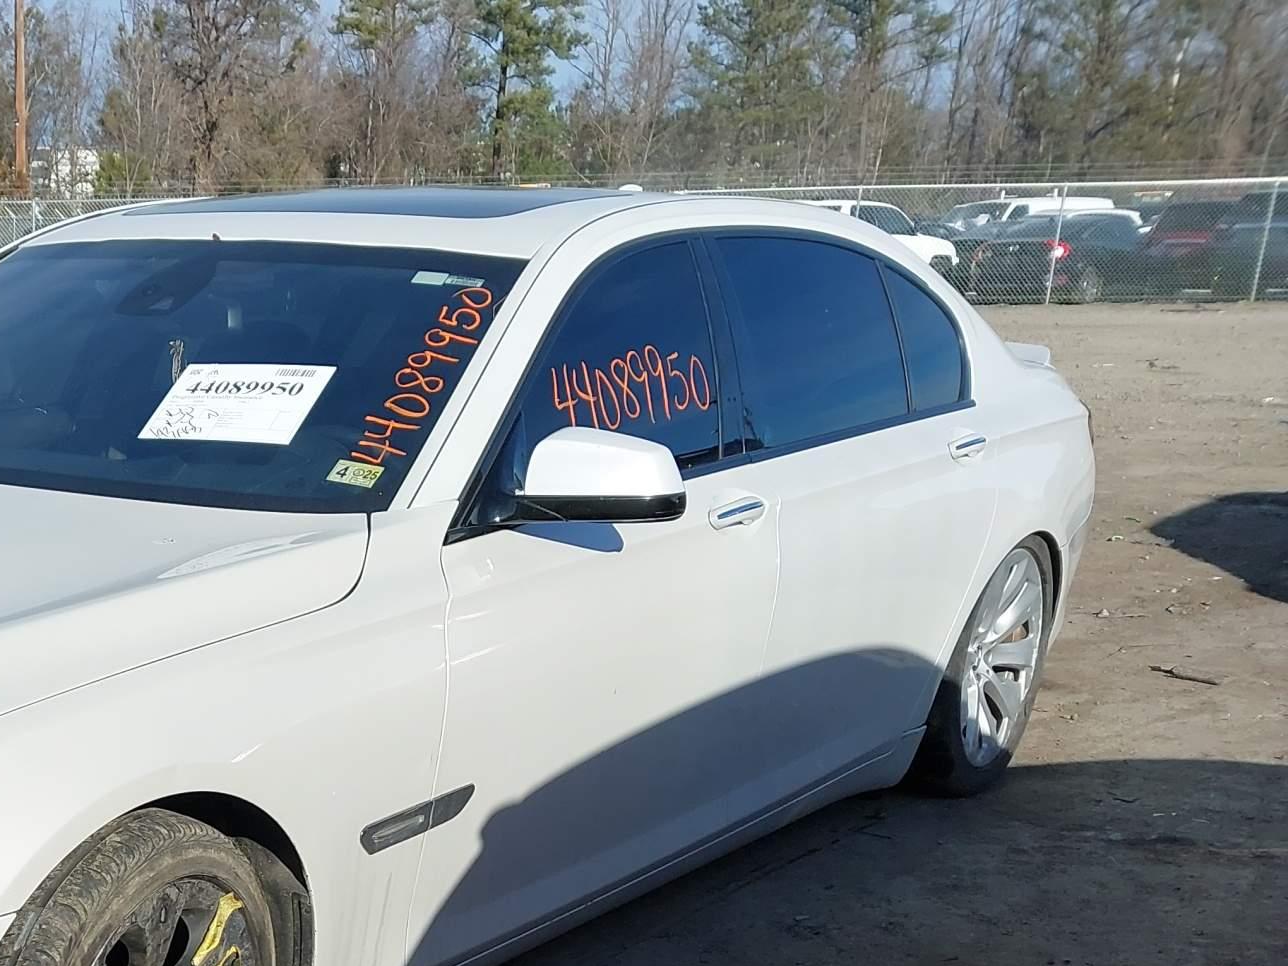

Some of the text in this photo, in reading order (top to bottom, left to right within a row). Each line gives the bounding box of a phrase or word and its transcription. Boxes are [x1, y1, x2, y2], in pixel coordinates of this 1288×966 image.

[186, 380, 304, 397] 44089950
[351, 287, 493, 464] 44089950
[551, 344, 710, 430] 44089950
[336, 466, 350, 479] 4
[363, 469, 380, 481] 25
